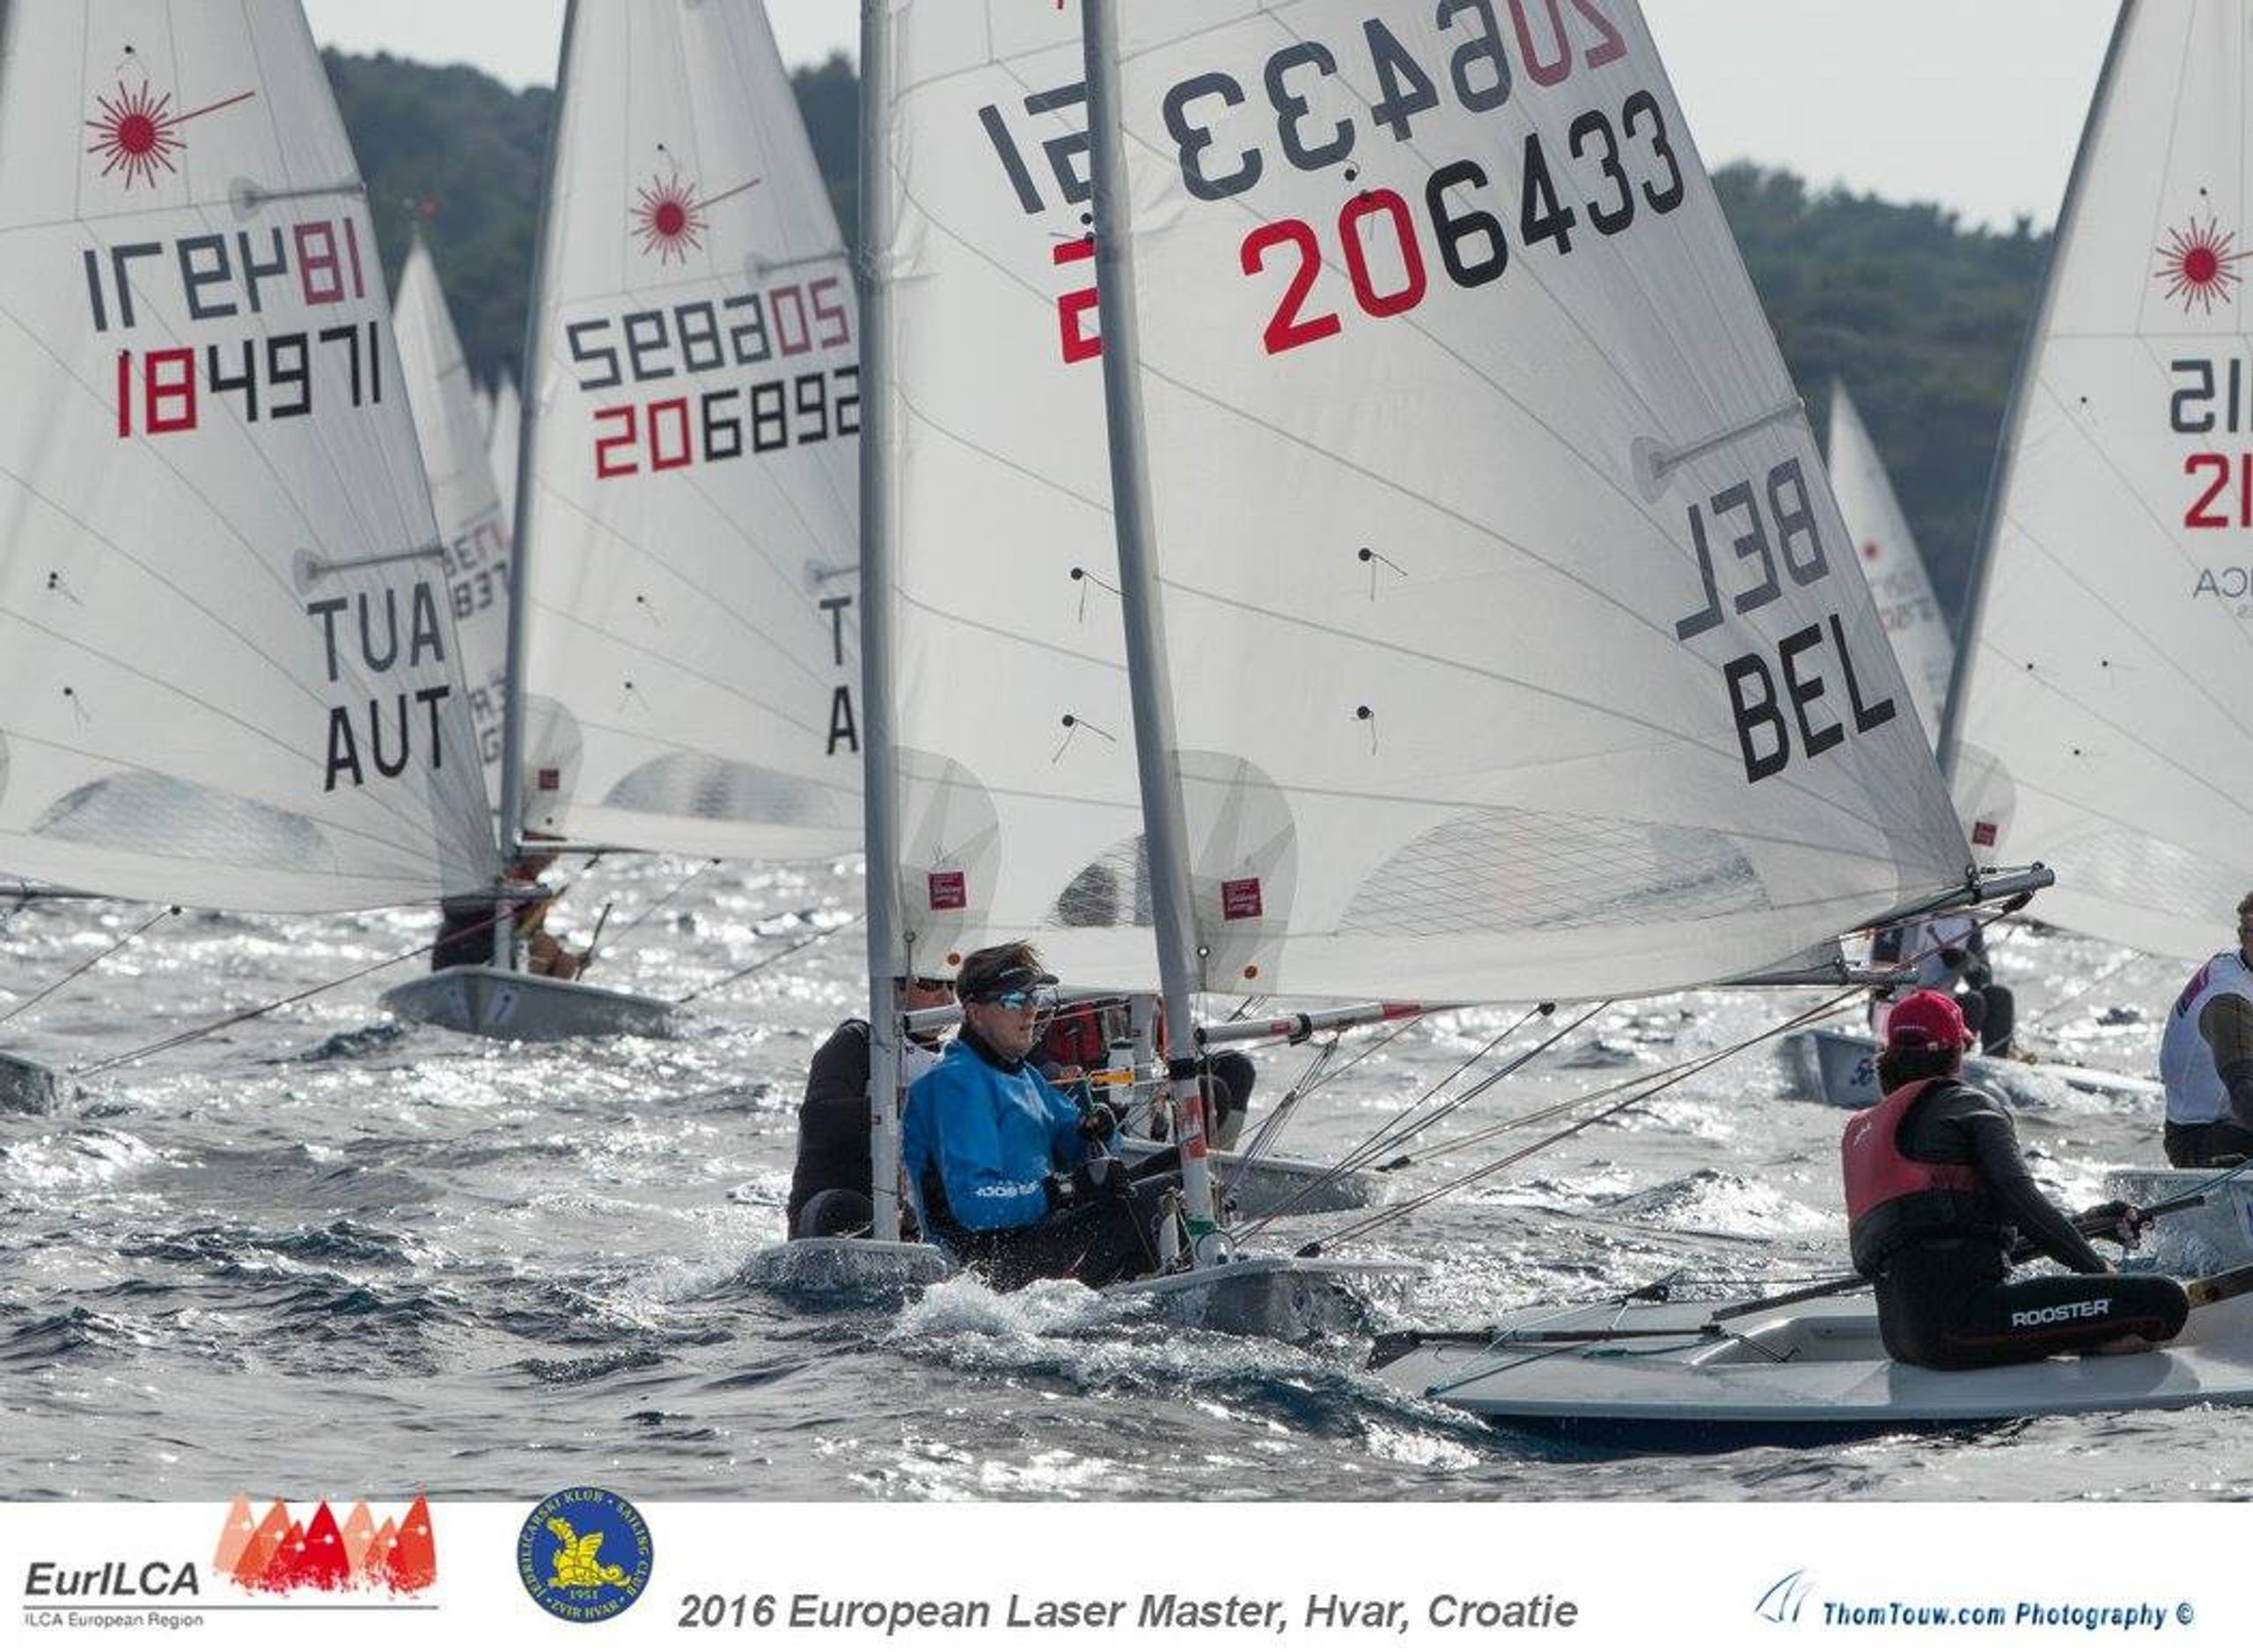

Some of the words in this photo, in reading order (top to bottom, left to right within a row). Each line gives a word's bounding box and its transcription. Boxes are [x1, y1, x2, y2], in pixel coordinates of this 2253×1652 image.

[1240, 89, 1684, 356] 206433
[118, 320, 381, 438] 184971
[592, 364, 860, 480] 206892
[325, 685, 451, 791] AUT
[1723, 613, 1896, 783] BEL
[2011, 1299, 2109, 1327] ROOSTER
